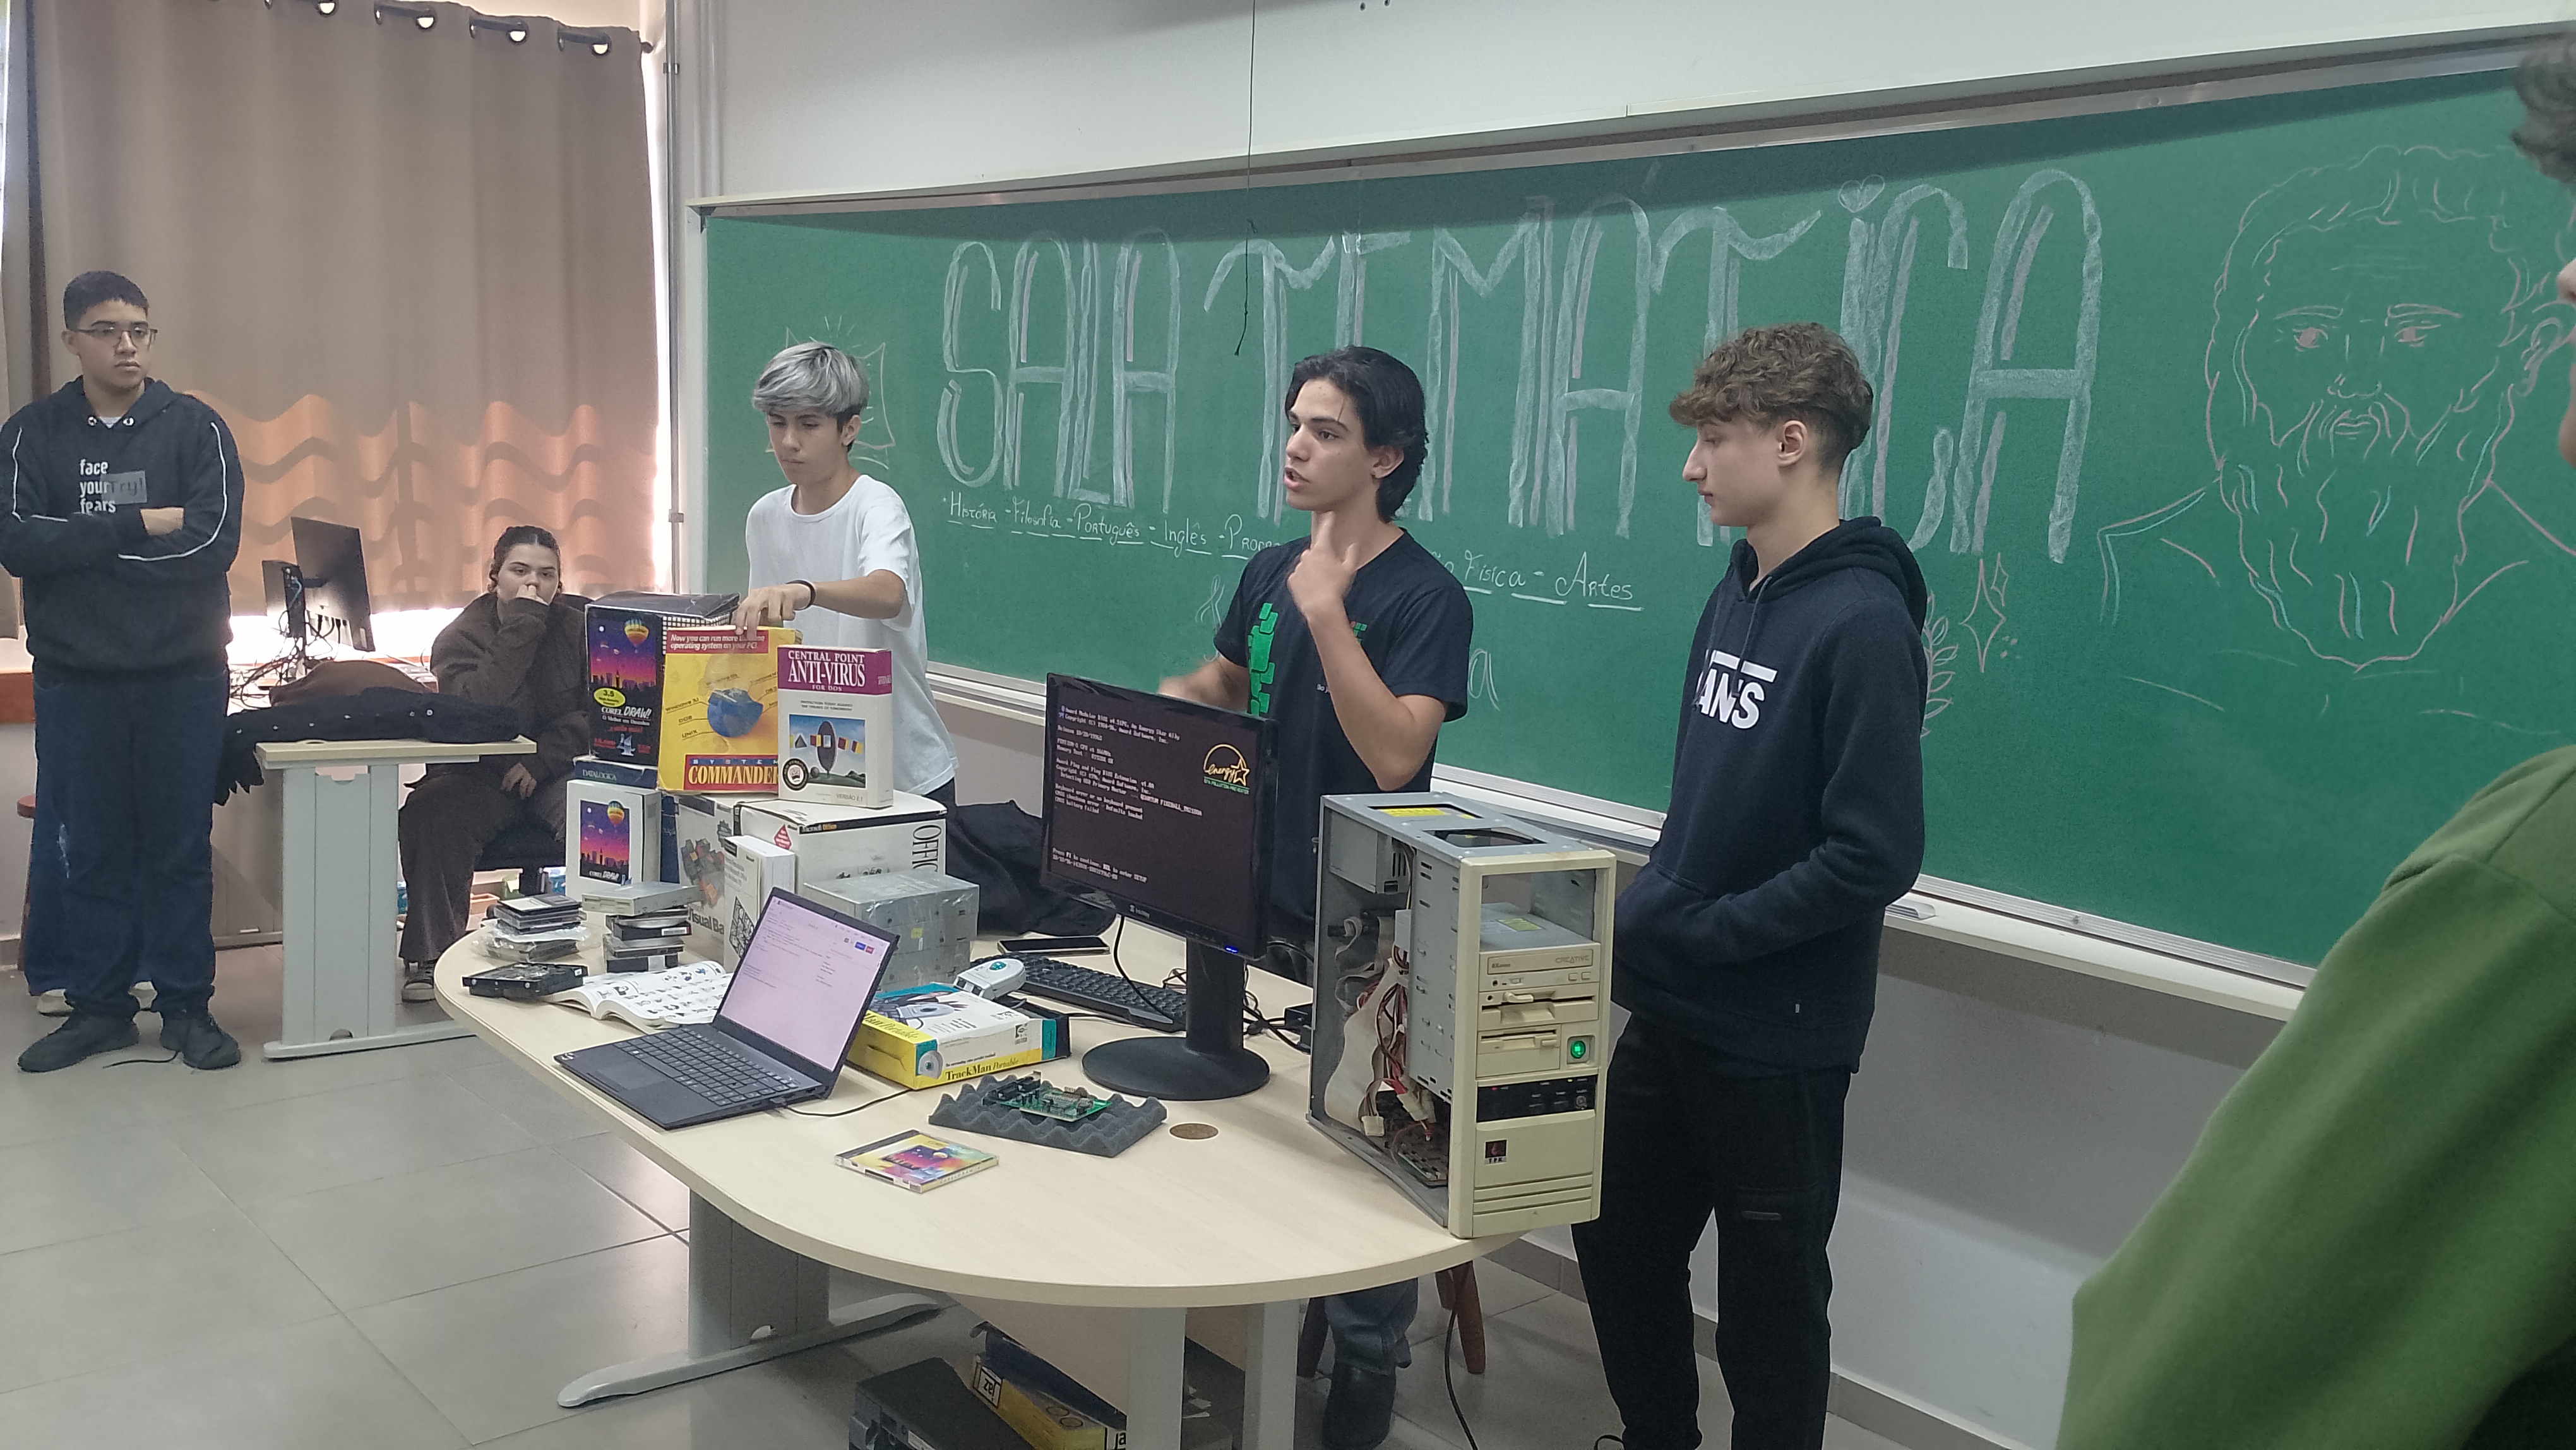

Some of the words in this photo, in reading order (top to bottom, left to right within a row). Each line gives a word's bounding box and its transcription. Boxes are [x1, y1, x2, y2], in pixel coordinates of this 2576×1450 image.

[937, 228, 1181, 513] SALA
[80, 458, 108, 476] face
[80, 481, 110, 498] your
[80, 498, 116, 514] fears
[1165, 518, 1207, 558] Inglês
[1555, 551, 1633, 600] Artes
[671, 634, 685, 642] Now
[671, 642, 700, 650] operating
[701, 642, 722, 650] system
[789, 650, 831, 661] CENTRAL
[834, 653, 865, 664] POINT
[788, 659, 866, 687] ANTI-VIRUS
[601, 707, 623, 716] COREL
[623, 706, 652, 719] DRAW!
[682, 729, 698, 738] UNIX
[836, 793, 856, 801] VERSÃO
[712, 917, 724, 935] Ba
[1555, 955, 1590, 963] CREATIVE
[945, 1064, 991, 1081] TrackMan
[993, 1057, 1019, 1070] Portable
[1114, 1432, 1126, 1450] ja
